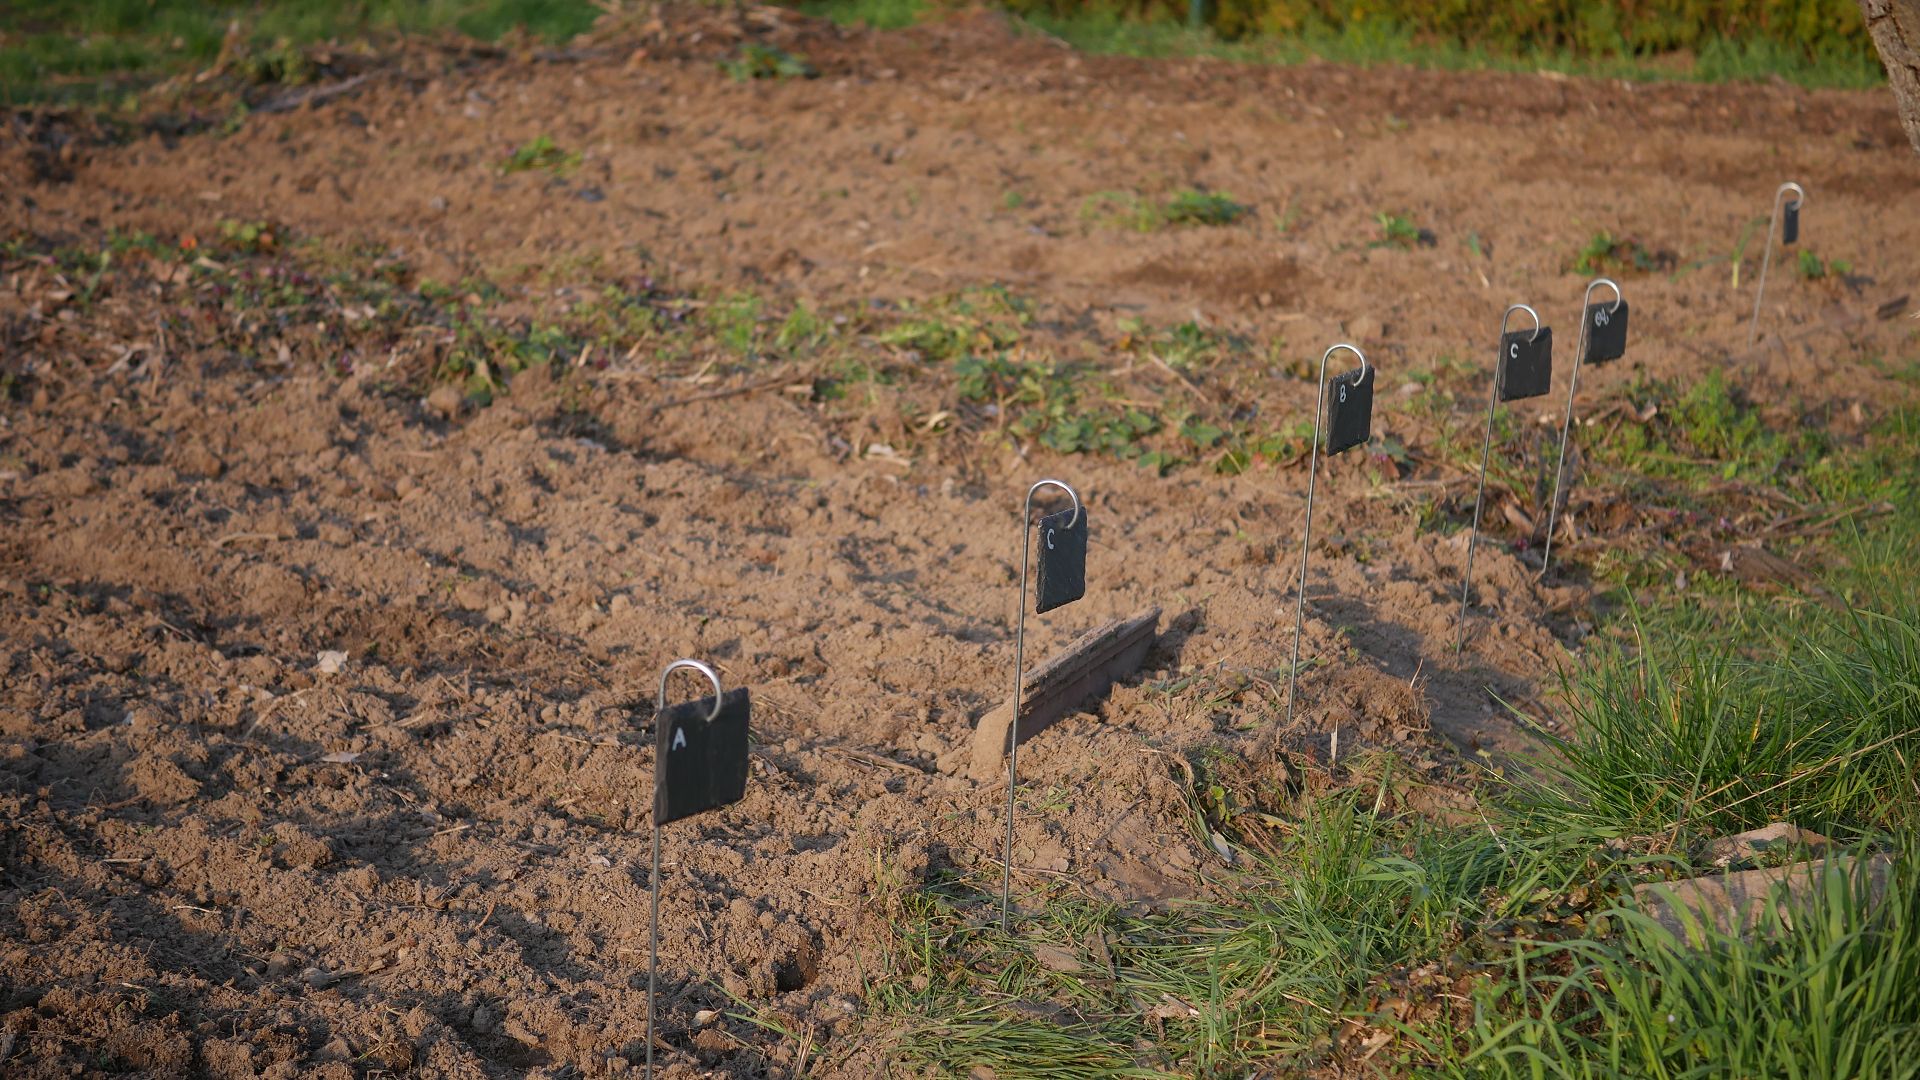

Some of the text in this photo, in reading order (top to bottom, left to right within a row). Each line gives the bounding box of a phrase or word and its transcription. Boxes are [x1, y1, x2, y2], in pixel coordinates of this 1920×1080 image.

[1510, 342, 1519, 359] C
[1047, 528, 1055, 550] C
[672, 727, 687, 751] A
